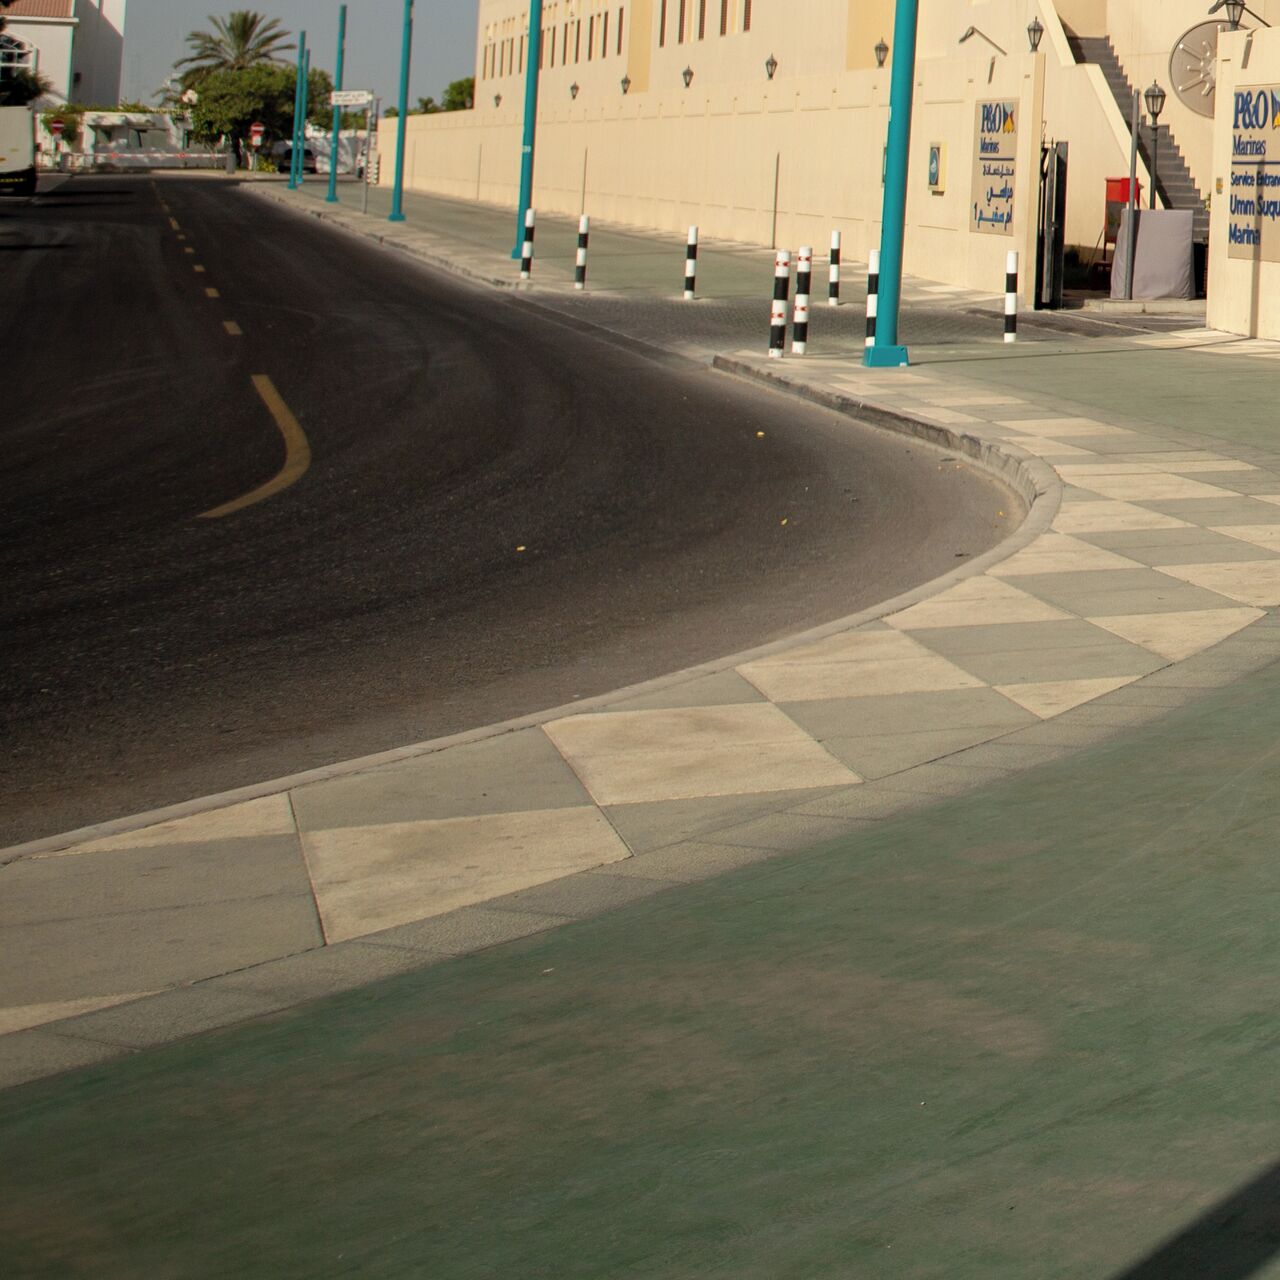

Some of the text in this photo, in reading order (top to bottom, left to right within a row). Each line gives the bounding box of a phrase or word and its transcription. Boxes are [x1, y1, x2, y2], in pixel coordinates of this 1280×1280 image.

[980, 102, 1002, 133] P&O
[1232, 89, 1269, 130] P&O
[1231, 171, 1255, 186] Service
[1230, 194, 1255, 216] Umm
[1228, 223, 1261, 245] Marina
